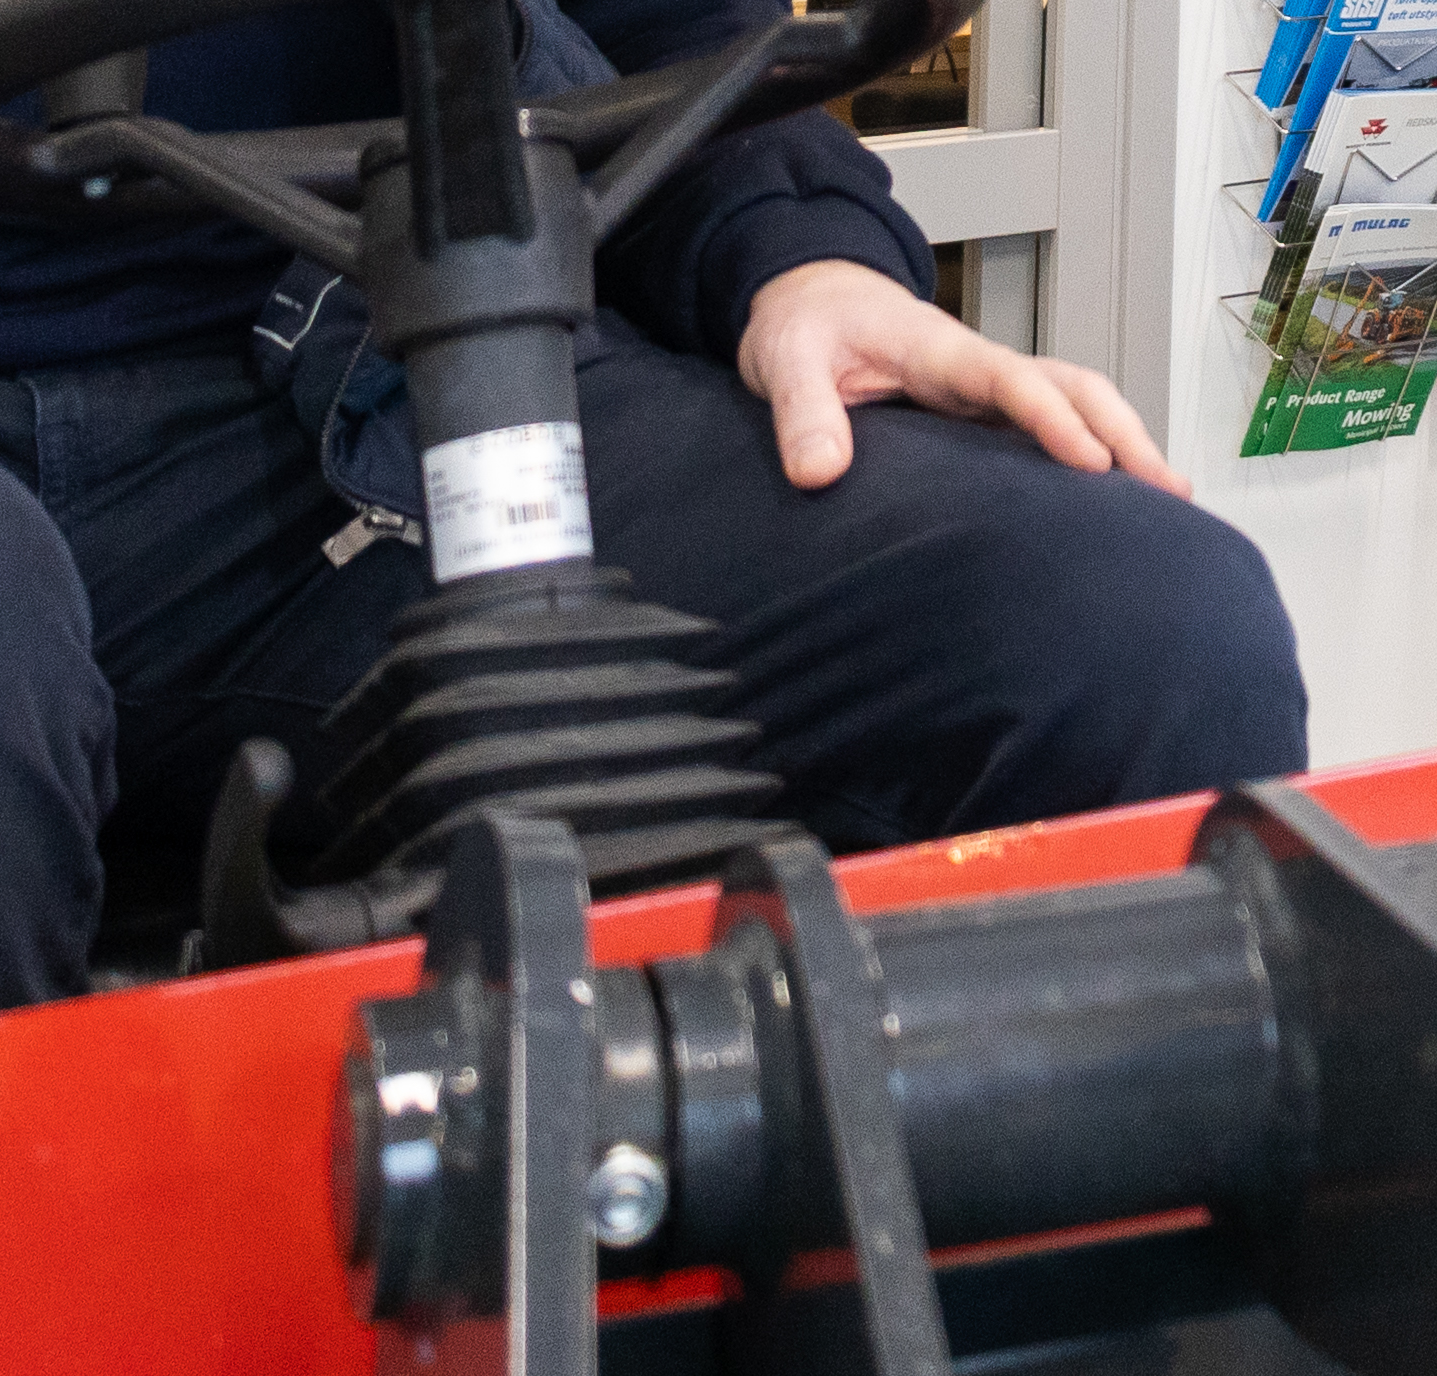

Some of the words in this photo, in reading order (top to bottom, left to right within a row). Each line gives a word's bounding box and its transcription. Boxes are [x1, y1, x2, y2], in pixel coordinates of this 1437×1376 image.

[1386, 10, 1408, 22] tøft
[1351, 217, 1411, 233] MULAG
[1345, 386, 1386, 403] Range
[1341, 402, 1416, 428] Mowing
